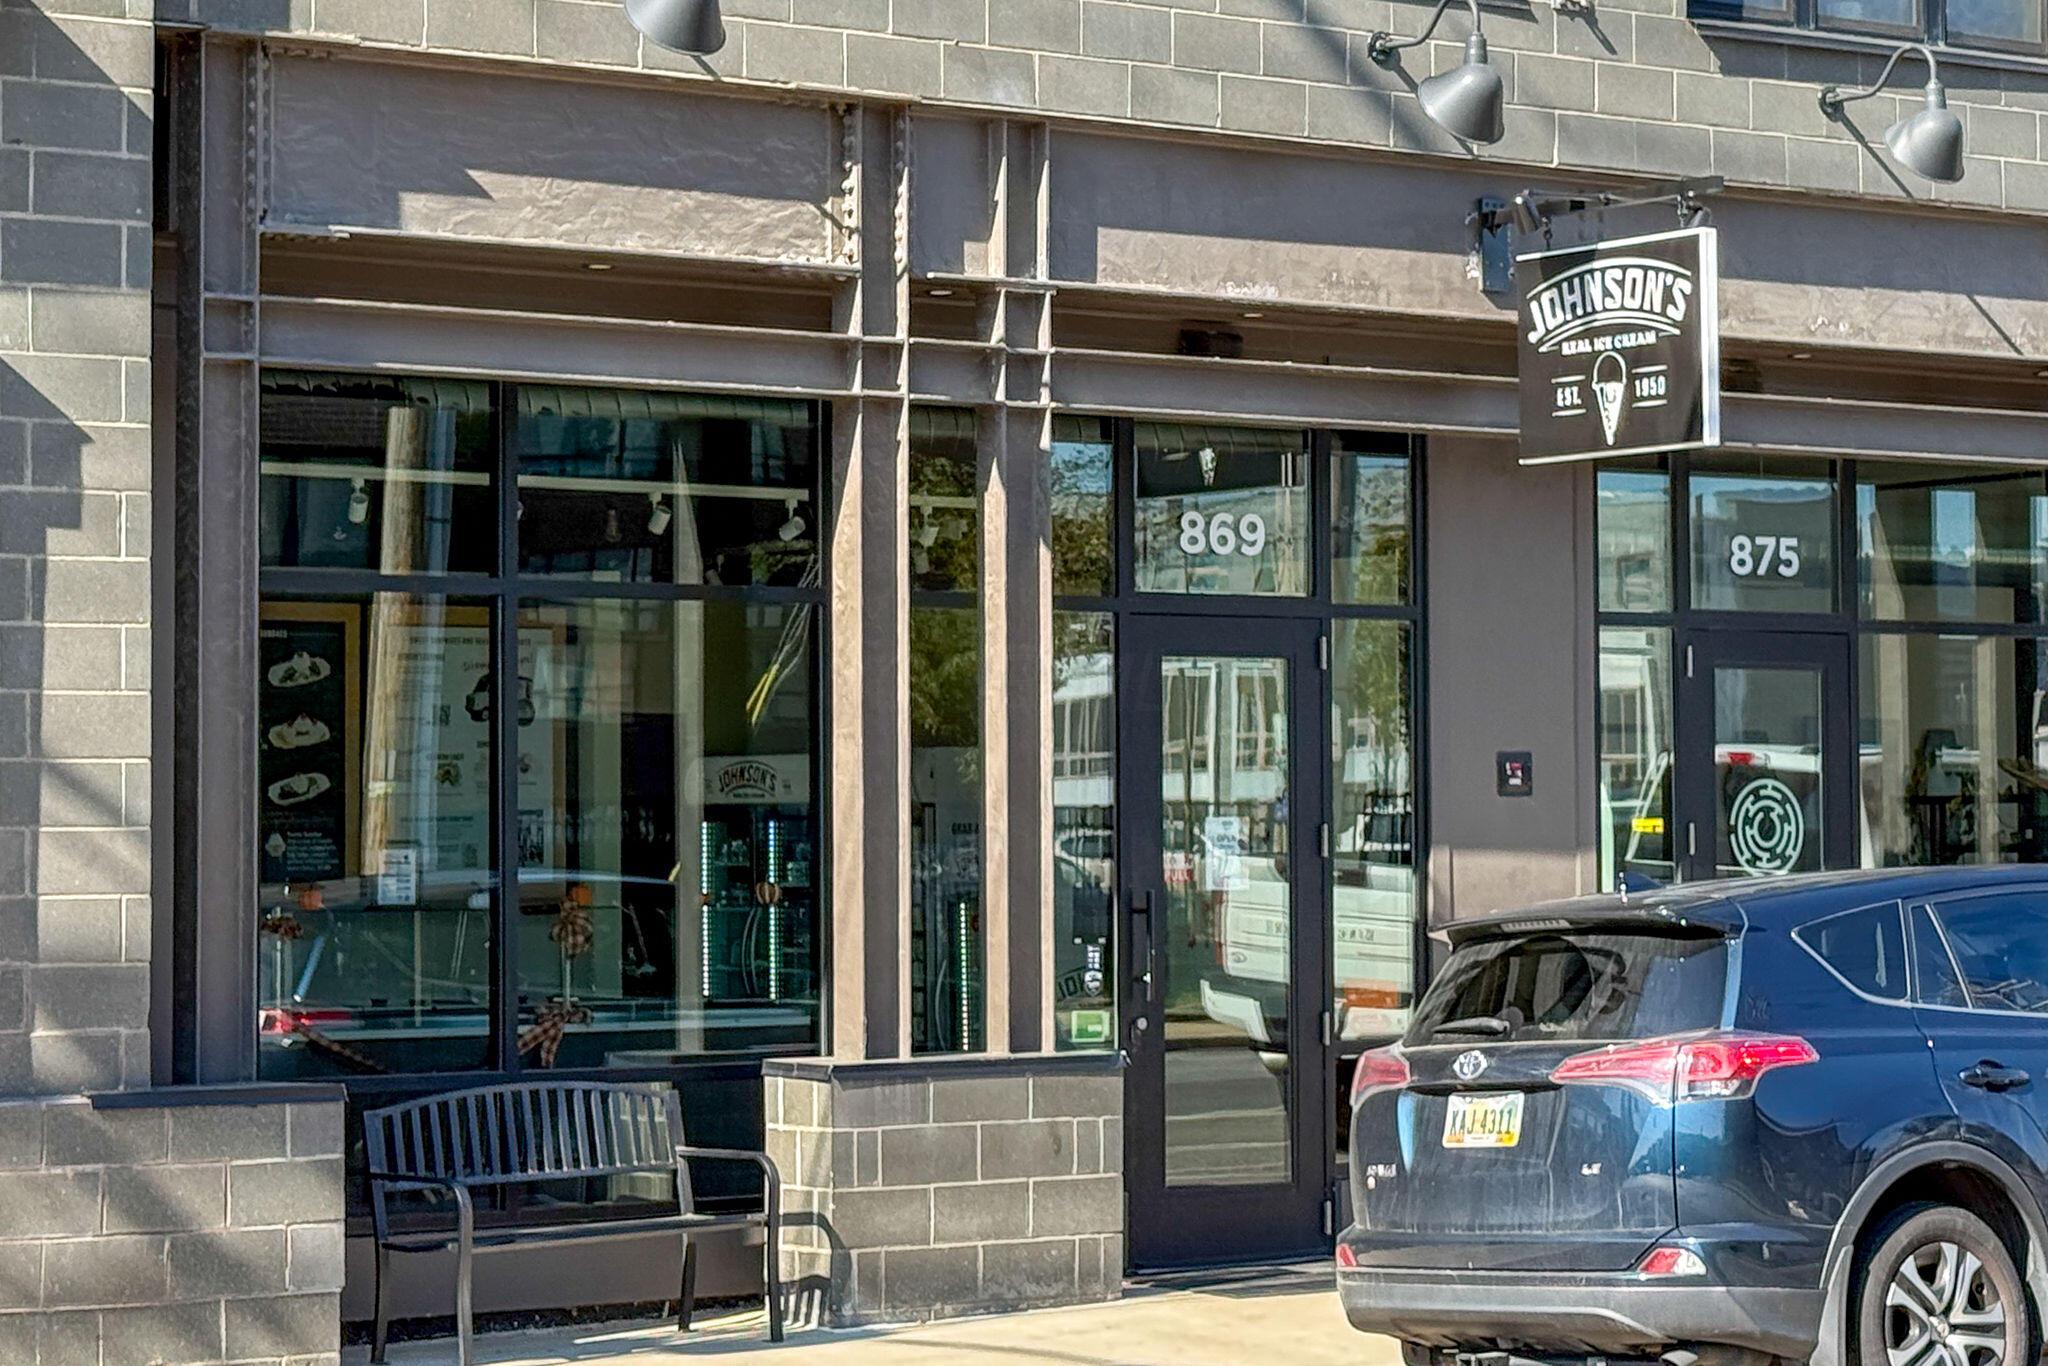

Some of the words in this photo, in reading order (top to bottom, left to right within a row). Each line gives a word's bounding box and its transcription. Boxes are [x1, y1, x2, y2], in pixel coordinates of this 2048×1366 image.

[1527, 267, 1693, 344] JOHNSON'S
[1561, 338, 1592, 355] REAL
[1594, 335, 1613, 351] ICE
[1614, 330, 1656, 349] CREAM
[1557, 386, 1582, 407] EST.
[1634, 375, 1666, 398] 1950
[1179, 511, 1266, 556] 869
[1729, 535, 1800, 577] 875
